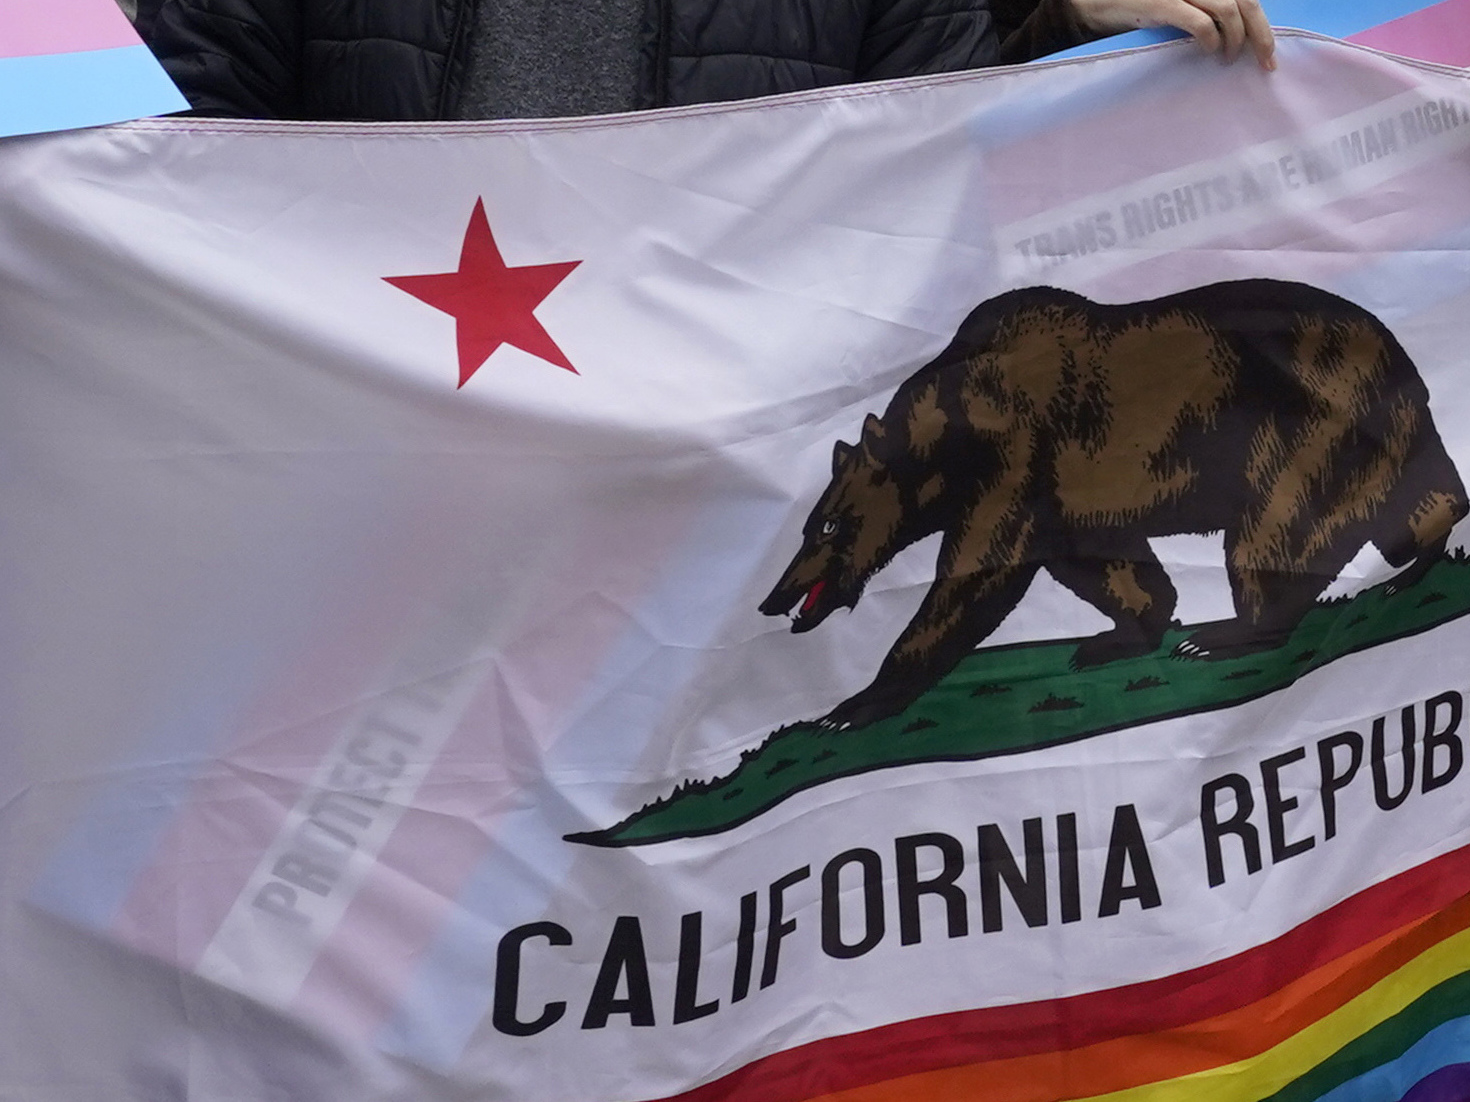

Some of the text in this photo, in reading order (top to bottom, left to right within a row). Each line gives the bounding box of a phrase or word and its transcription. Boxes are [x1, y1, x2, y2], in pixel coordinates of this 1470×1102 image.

[1013, 210, 1118, 265] TRANS
[1119, 175, 1236, 240] RIGHTS
[492, 804, 1162, 1037] CALIFORNIA
